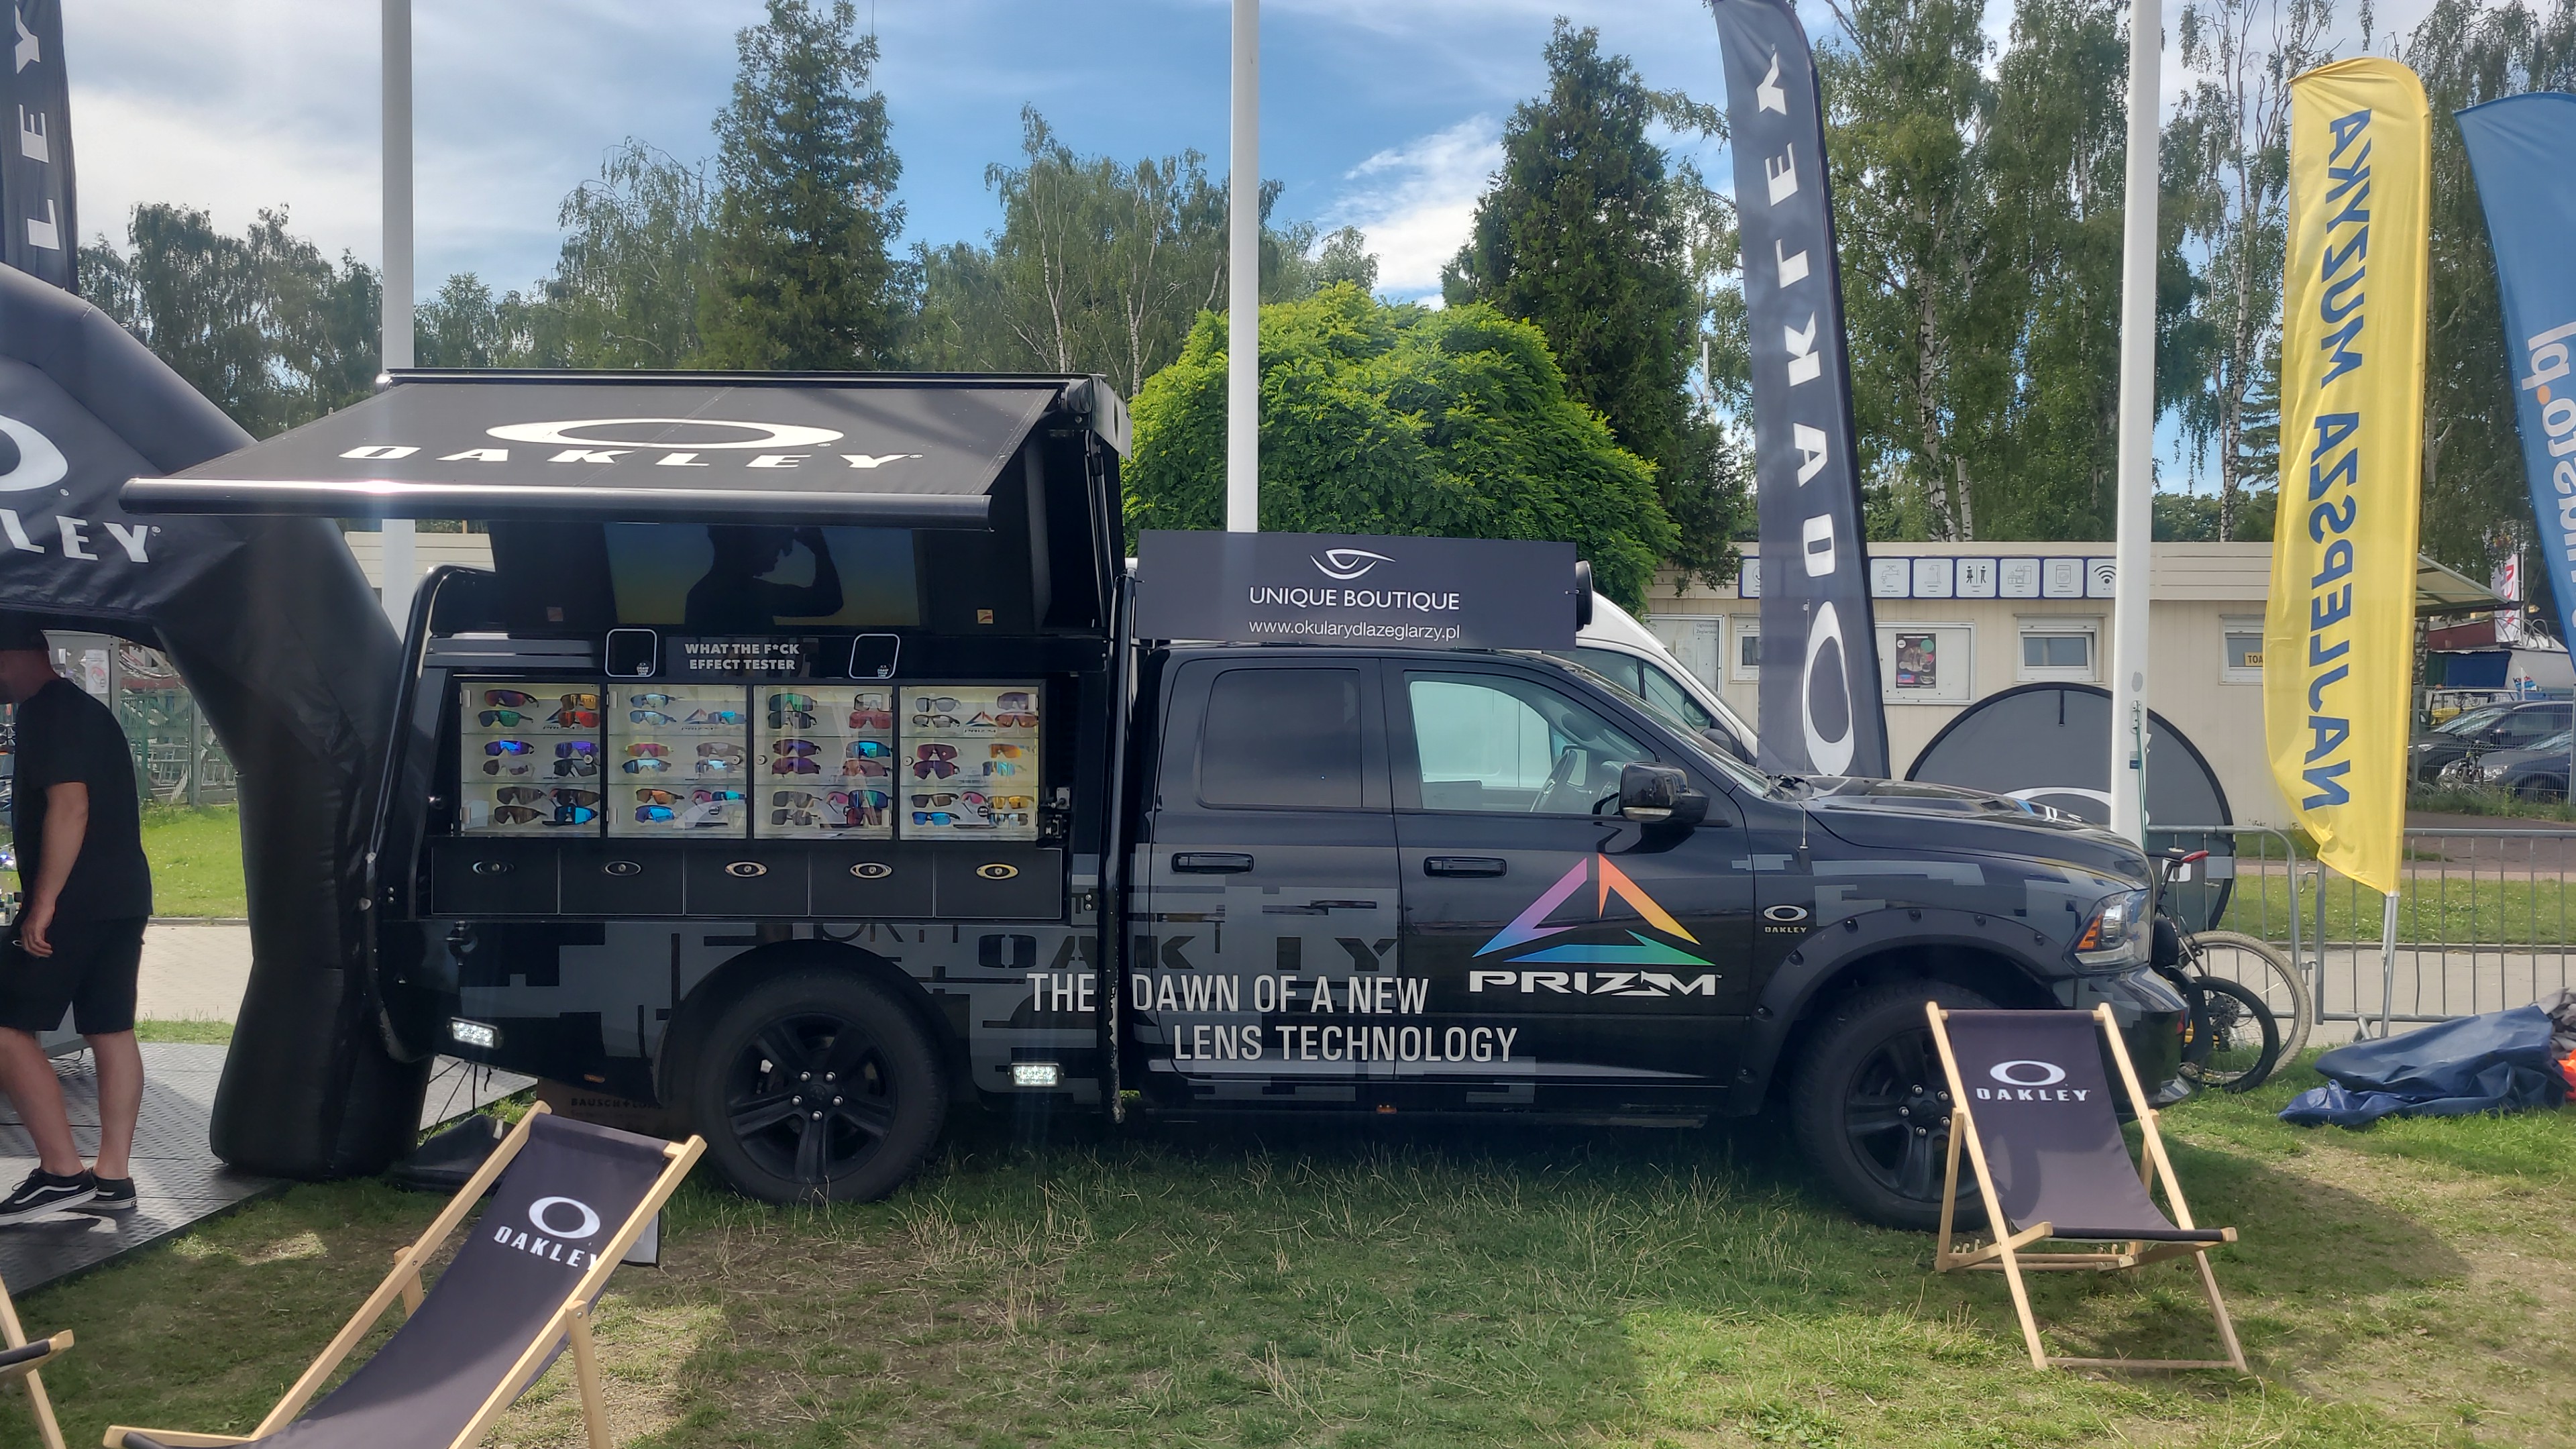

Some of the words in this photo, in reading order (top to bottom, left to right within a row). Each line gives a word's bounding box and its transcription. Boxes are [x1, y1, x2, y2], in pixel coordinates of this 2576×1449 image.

[15, 4, 60, 251] LEY
[338, 445, 910, 468] OAKLEY
[1248, 586, 1338, 608] UNIQUE
[1344, 590, 1460, 612] BOUTIQUE
[1248, 619, 1461, 642] www.okularydlazeglarzy.pl
[685, 643, 729, 654] WHAT
[731, 644, 760, 655] THE
[690, 659, 741, 669] EFFECT
[743, 659, 796, 670] TESTER
[1764, 926, 1807, 934] OAKLEY
[1026, 973, 1095, 1012] THE
[1132, 974, 1240, 1014] DAWN
[1253, 975, 1297, 1014] OF
[1310, 975, 1335, 1014] A
[1348, 976, 1430, 1015] NEW
[1173, 1024, 1263, 1061] LENS
[1275, 1026, 1518, 1063] TECHNOLOGY
[1976, 1088, 2088, 1102] OAKLEY
